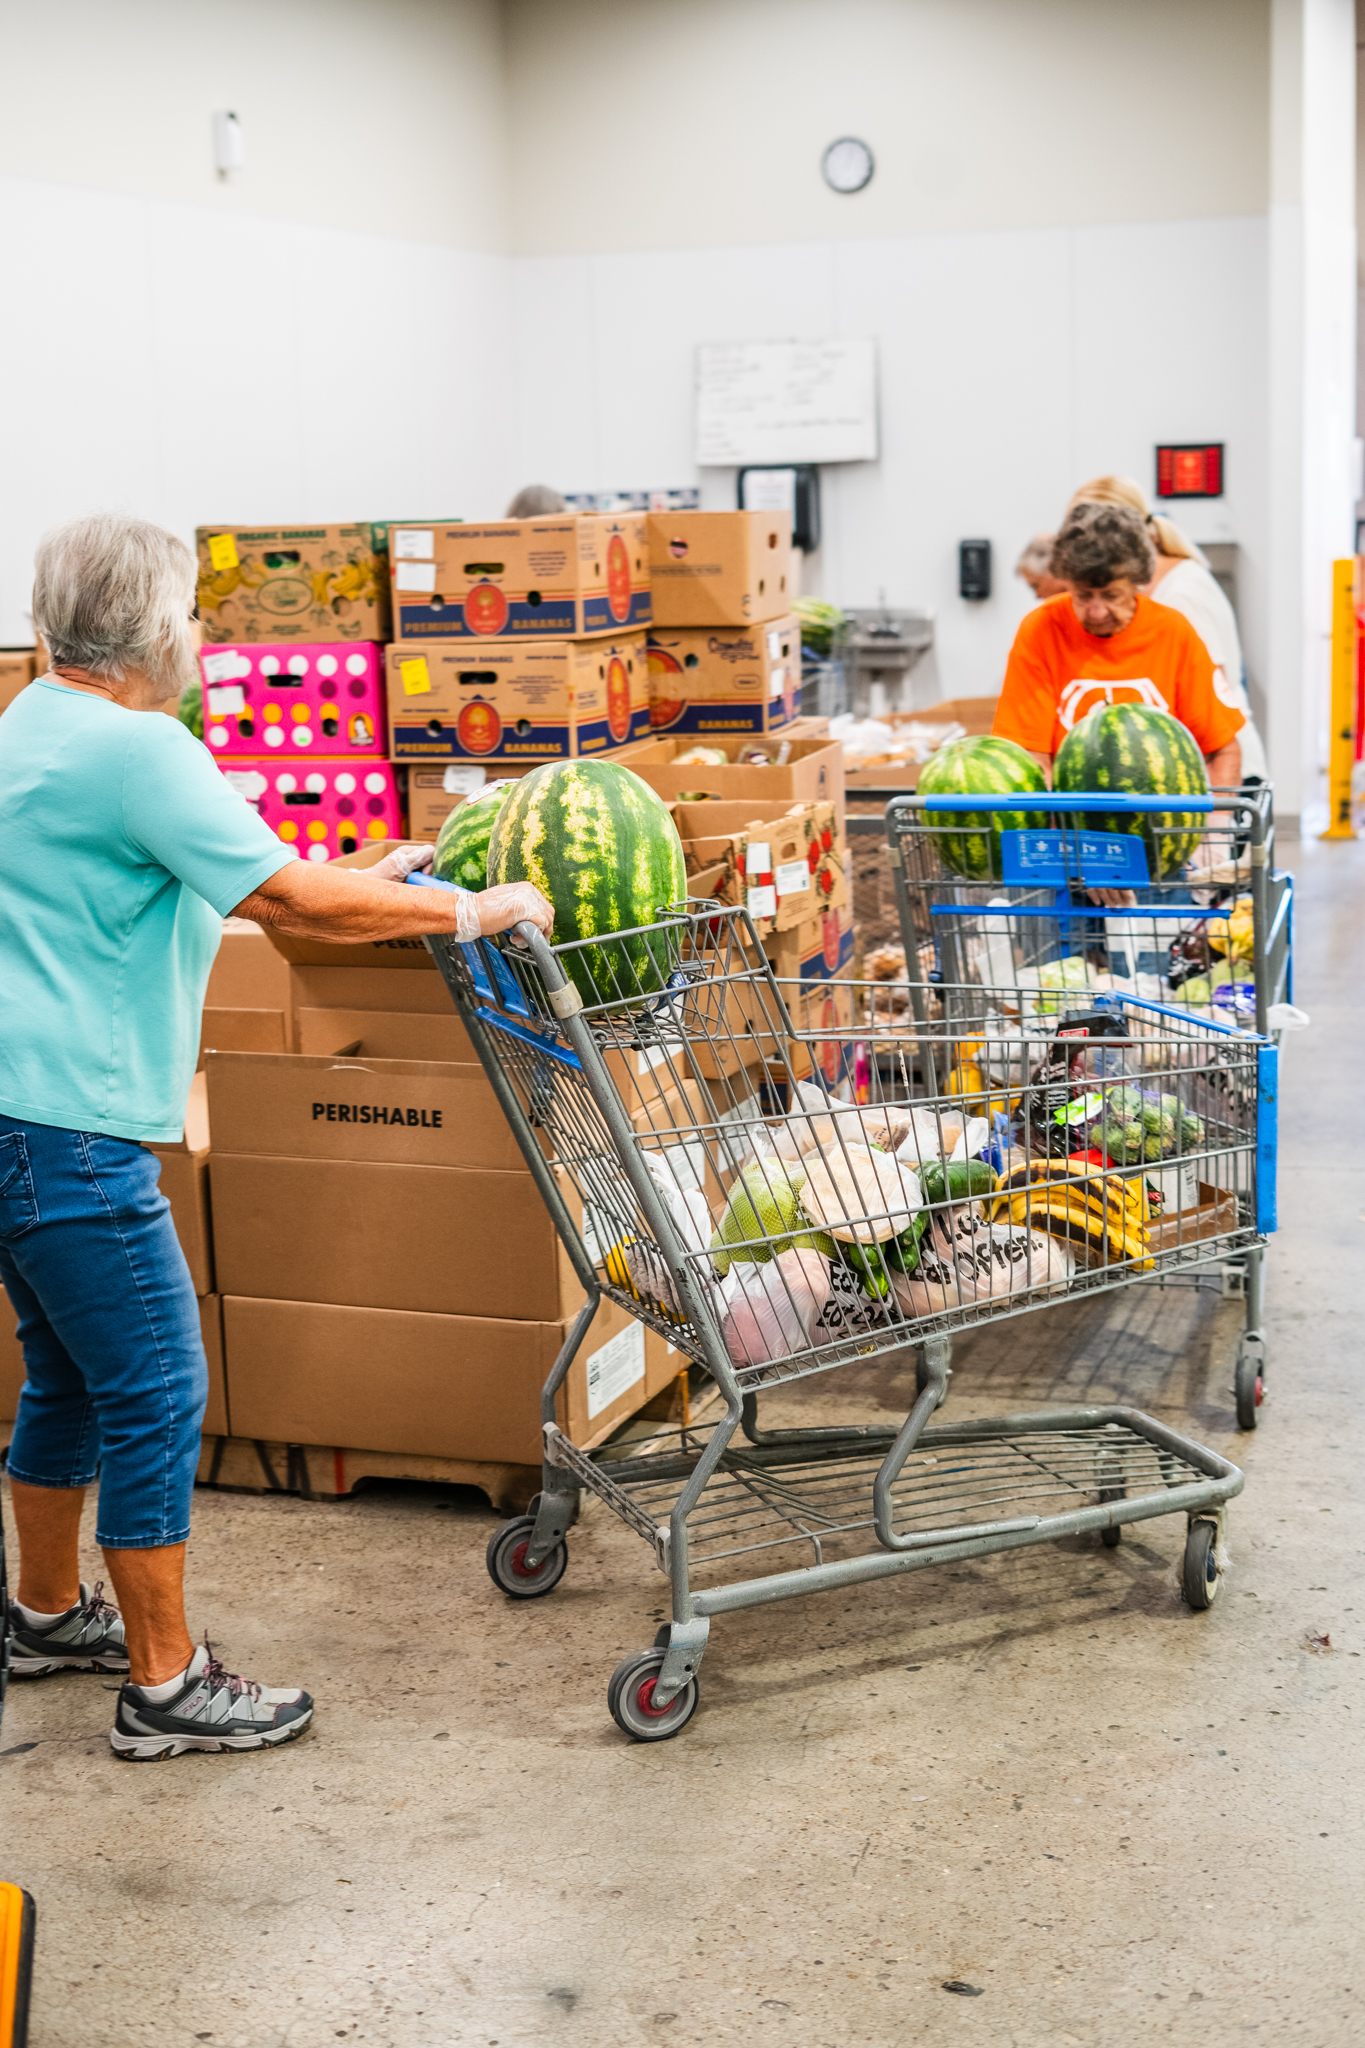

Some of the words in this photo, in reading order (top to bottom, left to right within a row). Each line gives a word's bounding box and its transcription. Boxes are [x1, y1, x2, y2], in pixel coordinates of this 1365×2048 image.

[404, 622, 463, 633] PREMIUM
[512, 618, 572, 630] BANANAS
[698, 720, 753, 730] BANANAS
[396, 743, 453, 753] PREMIUM
[504, 743, 562, 753] BANANAS
[312, 1103, 442, 1128] PERISHABLE
[182, 1696, 203, 1715] FILA
